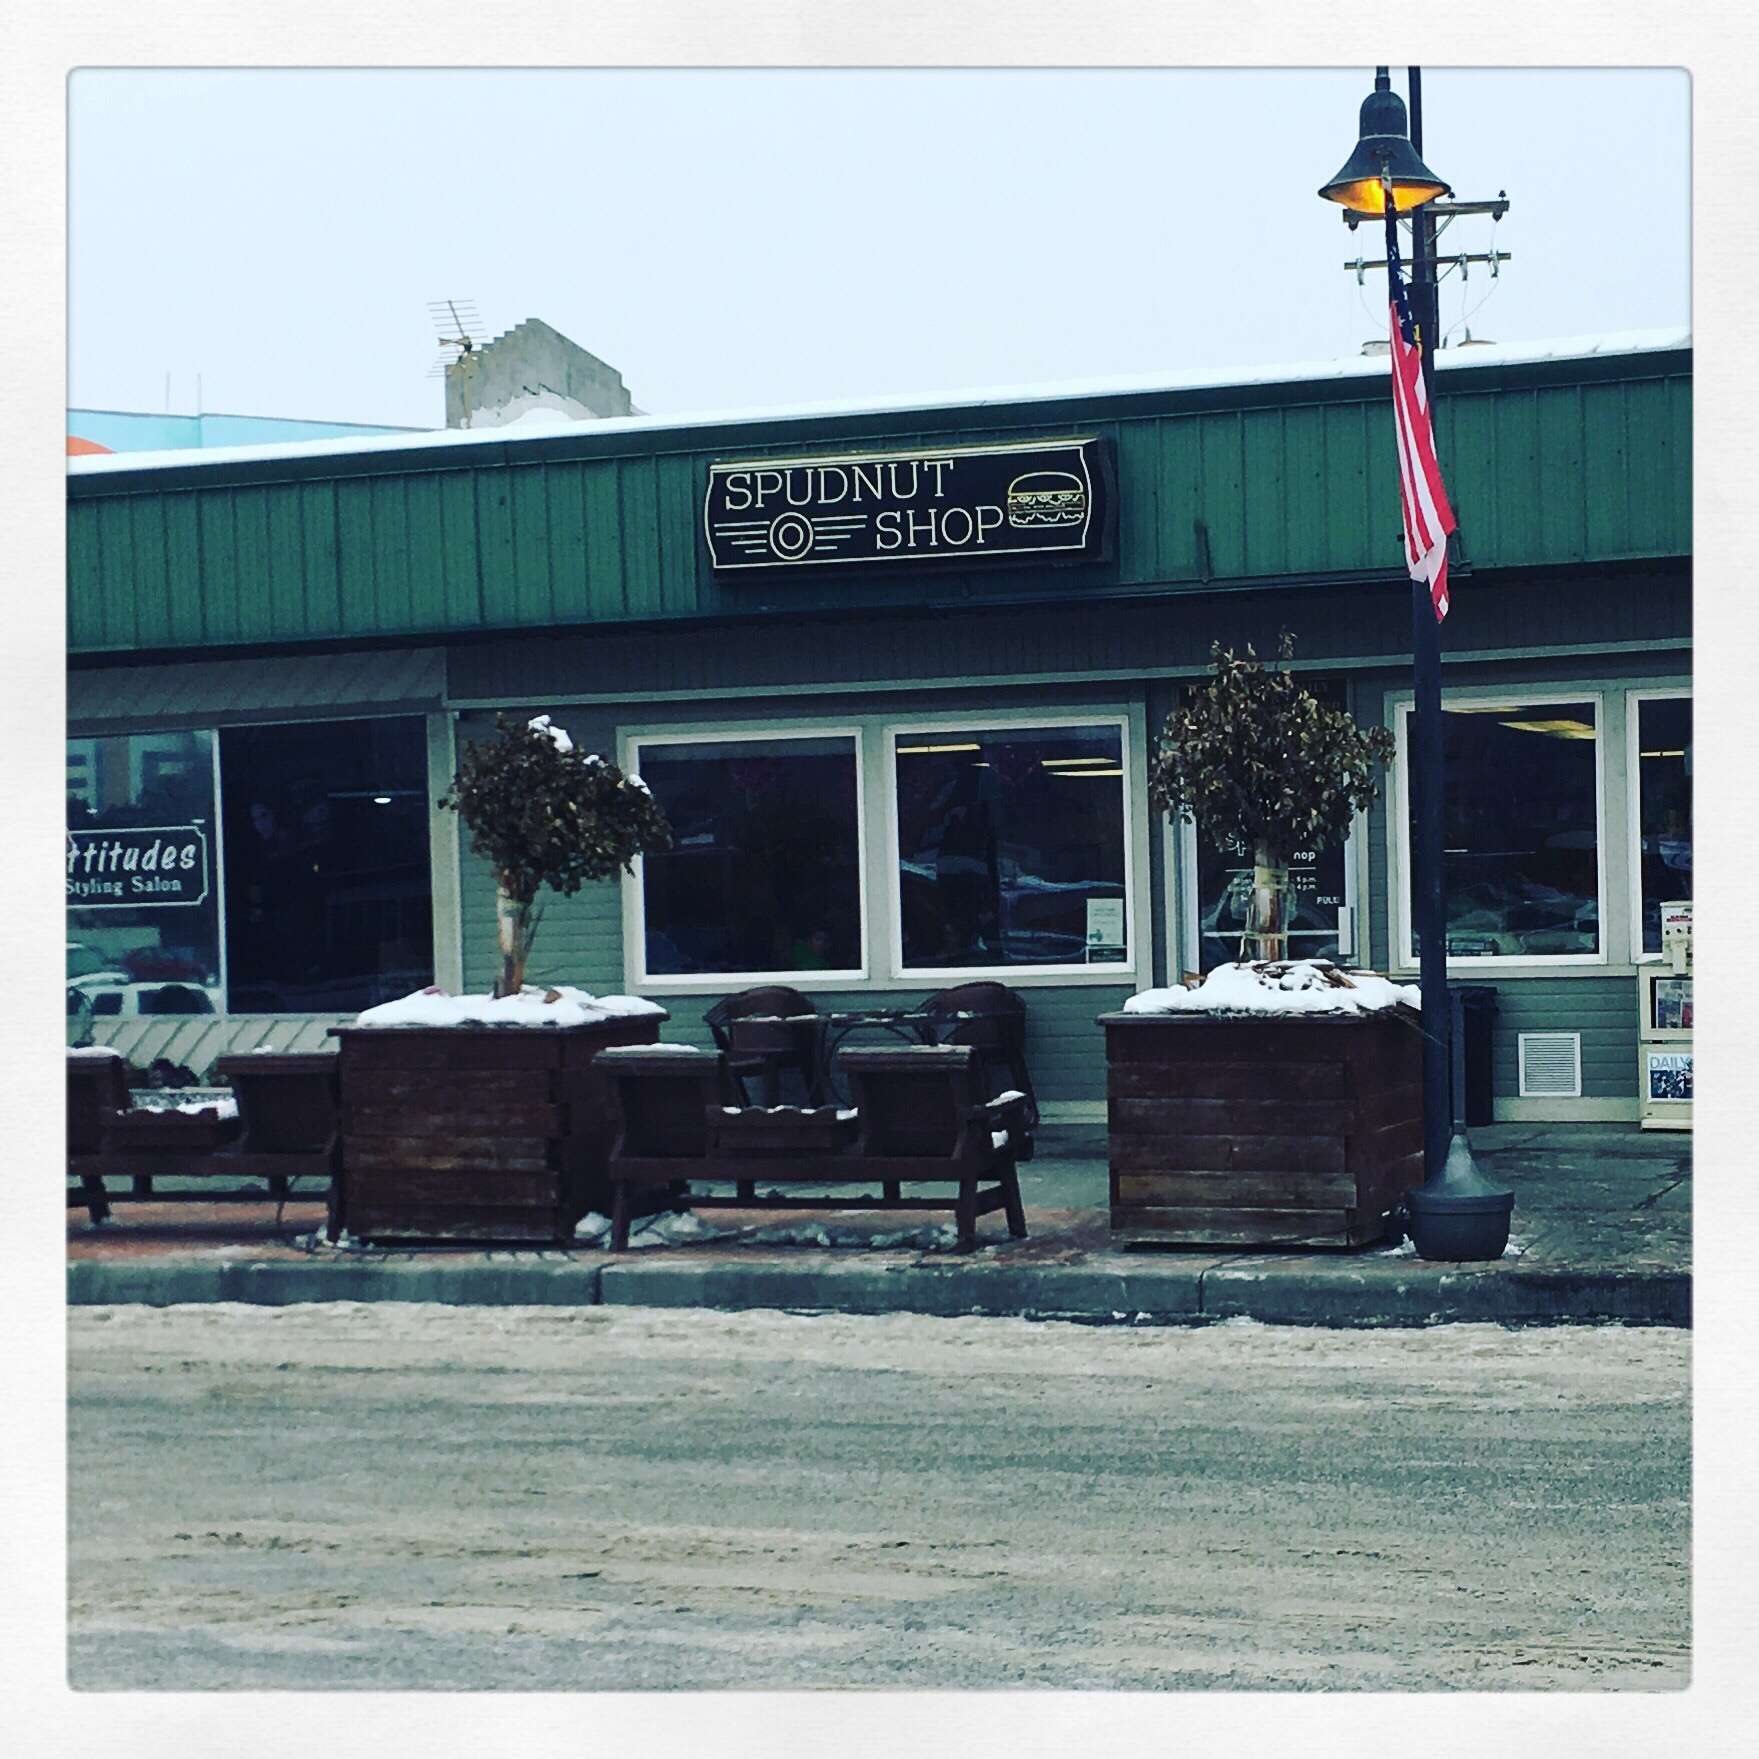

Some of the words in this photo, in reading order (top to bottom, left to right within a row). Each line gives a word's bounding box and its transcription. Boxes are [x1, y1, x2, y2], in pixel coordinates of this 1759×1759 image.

[725, 459, 954, 511] SPUDNUT
[876, 505, 1004, 550] SHOP
[66, 878, 123, 897] Styling
[131, 876, 182, 892] Salon
[1650, 1056, 1690, 1069] DAILY
